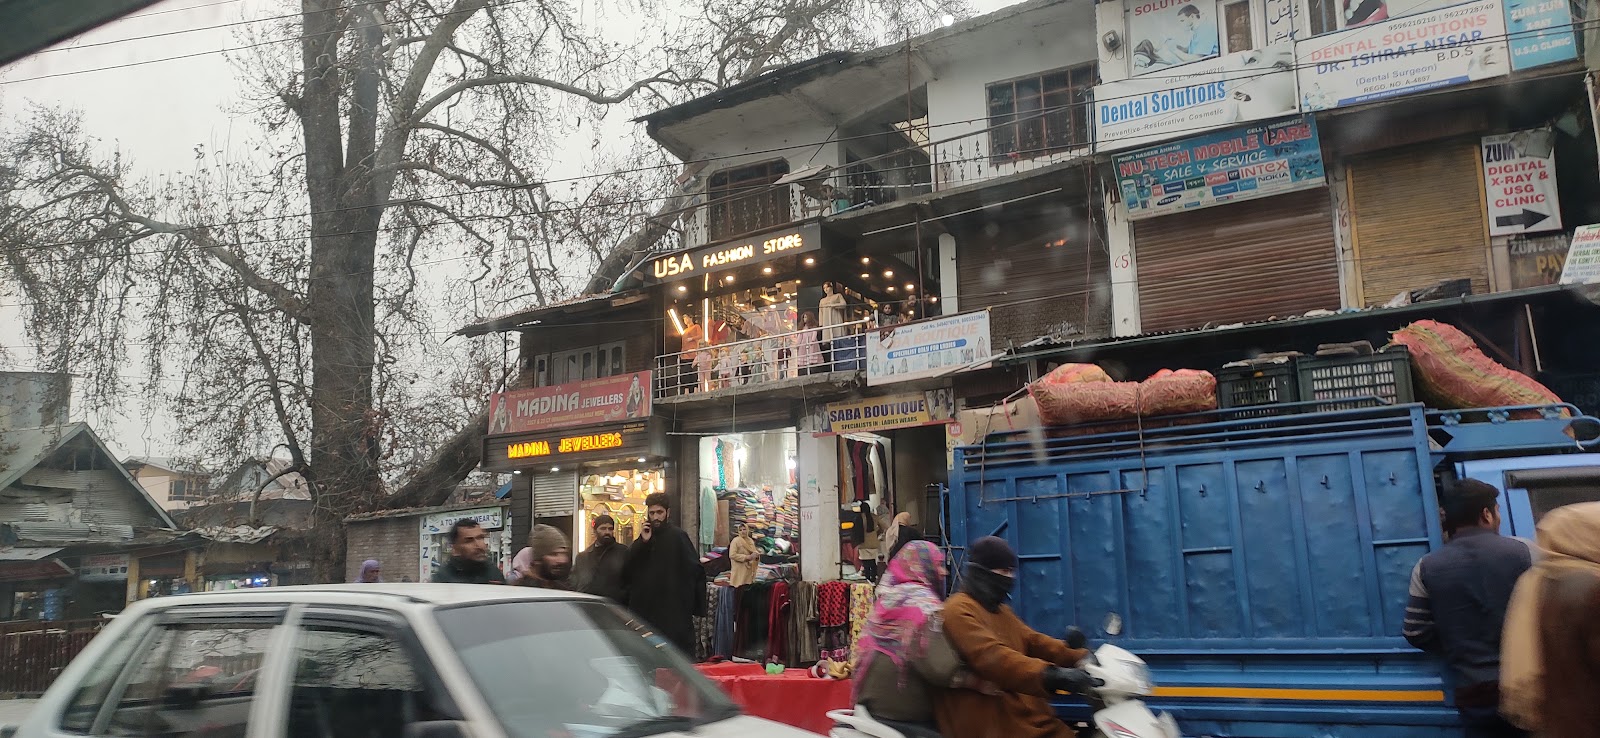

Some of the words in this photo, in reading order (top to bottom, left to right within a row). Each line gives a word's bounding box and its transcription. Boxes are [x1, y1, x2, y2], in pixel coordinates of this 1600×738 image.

[1511, 6, 1536, 20] ZUM
[1311, 38, 1377, 62] DENTAL
[1382, 14, 1488, 46] SOLUTIONS
[1540, 37, 1571, 50] CLINIC
[1316, 61, 1345, 75] DR.
[1350, 43, 1418, 68] ISHRAT
[1424, 30, 1482, 51] NISAR
[1437, 45, 1474, 62] B.D.S
[1355, 73, 1389, 87] (Dental
[1392, 63, 1437, 79] Surgeon)
[1101, 96, 1148, 125] Dental
[1151, 82, 1226, 113] Solutions
[1188, 108, 1224, 121] Cosmetic
[1119, 150, 1191, 178] NU-TECH
[1193, 134, 1260, 161] MOBILE
[1263, 123, 1312, 146] CARE
[1485, 143, 1516, 163] ZUM
[1164, 165, 1193, 182] SALE
[1212, 149, 1267, 172] SERVICE
[1488, 160, 1547, 176] DIGITAL
[1258, 172, 1289, 183] NOKIA
[1491, 172, 1533, 187] X-RAY
[1538, 171, 1549, 180] &
[1503, 184, 1535, 196] USG
[1494, 194, 1545, 208] CLINIC
[654, 253, 694, 278] USA
[702, 244, 753, 268] FASHION
[763, 233, 802, 254] STORE
[914, 323, 980, 345] BOUTIQUE
[516, 391, 580, 418] MADINA
[581, 392, 624, 409] JEWELLERS
[829, 407, 861, 422] SABA
[864, 399, 925, 419] BOUTIQUE
[841, 421, 872, 430] SPECIALISTS
[881, 418, 899, 426] LADIES
[507, 440, 551, 459] MADINA
[558, 431, 622, 453] JEWELLERS
[422, 547, 429, 559] Z
